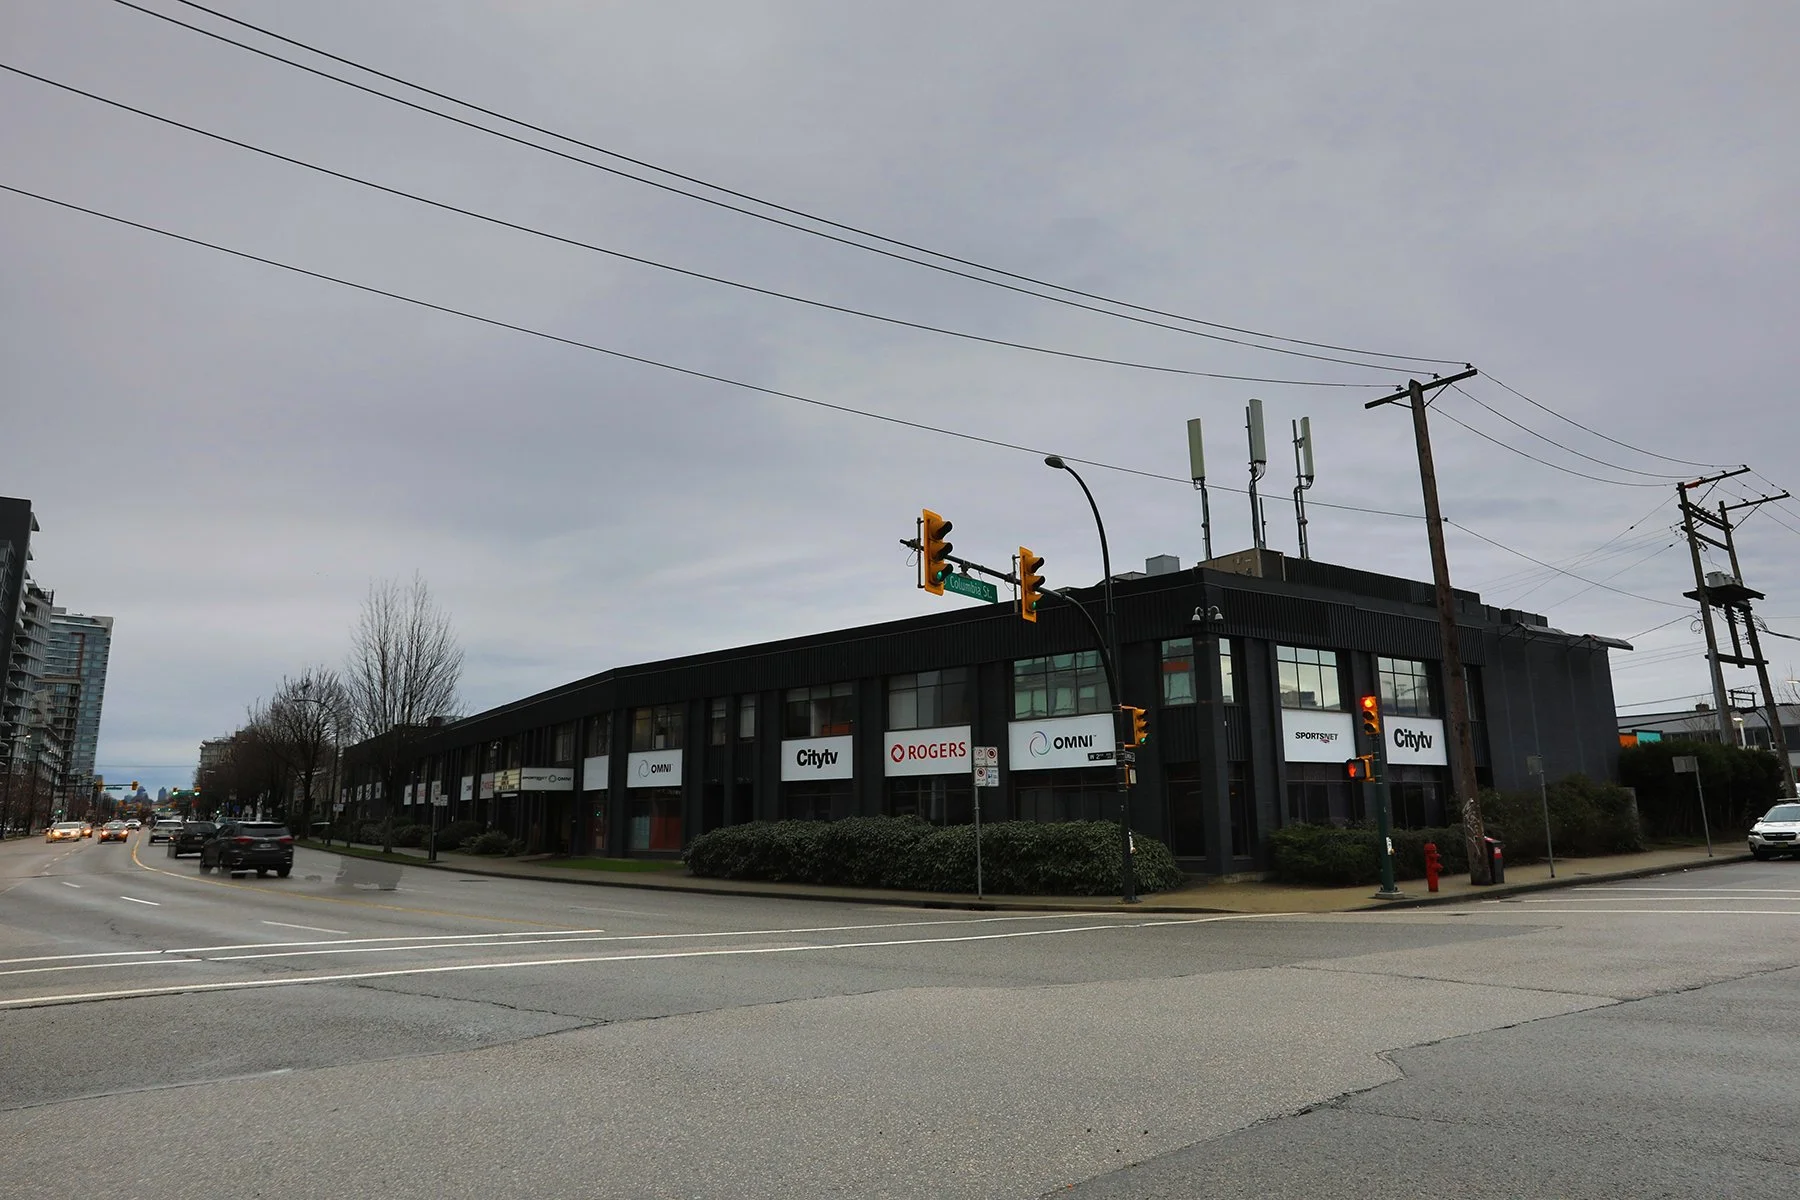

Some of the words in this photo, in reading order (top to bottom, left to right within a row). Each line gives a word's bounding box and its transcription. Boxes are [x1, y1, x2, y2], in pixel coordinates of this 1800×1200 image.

[949, 575, 982, 598] Columbia
[983, 585, 993, 599] St.
[1053, 734, 1093, 751] OMNI
[1295, 731, 1338, 741] SPORTSNET
[1393, 728, 1433, 752] Citytv
[796, 748, 839, 769] Citytv
[907, 741, 967, 760] ROGERS
[650, 763, 672, 774] OMNI
